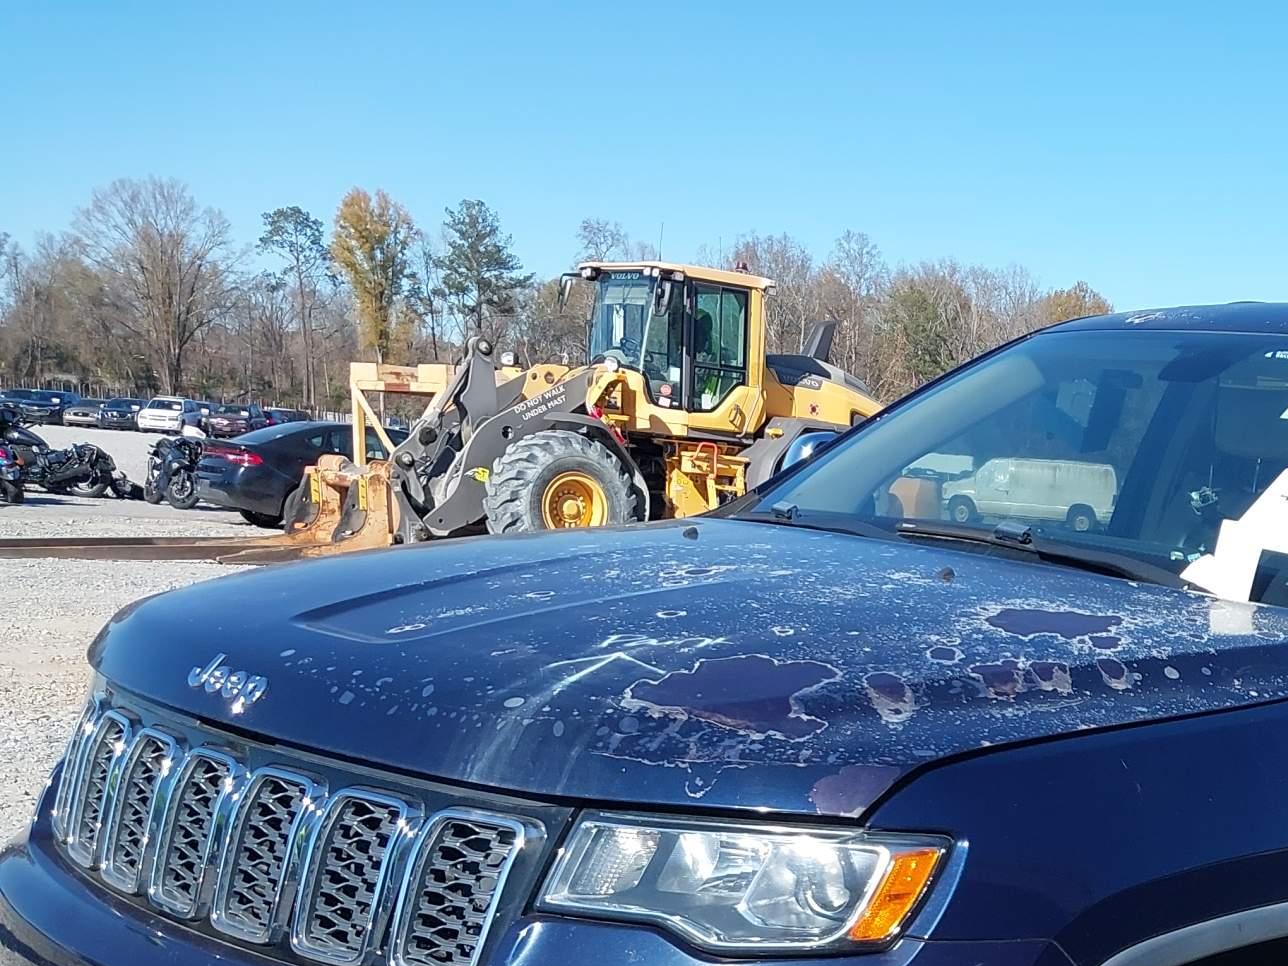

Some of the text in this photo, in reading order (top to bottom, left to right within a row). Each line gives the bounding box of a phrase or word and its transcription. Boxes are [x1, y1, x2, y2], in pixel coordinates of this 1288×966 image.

[610, 272, 640, 280] VOLVO
[514, 385, 566, 414] DO NOT WALK
[522, 395, 566, 421] UNDER MAST
[187, 652, 268, 714] Jeep
